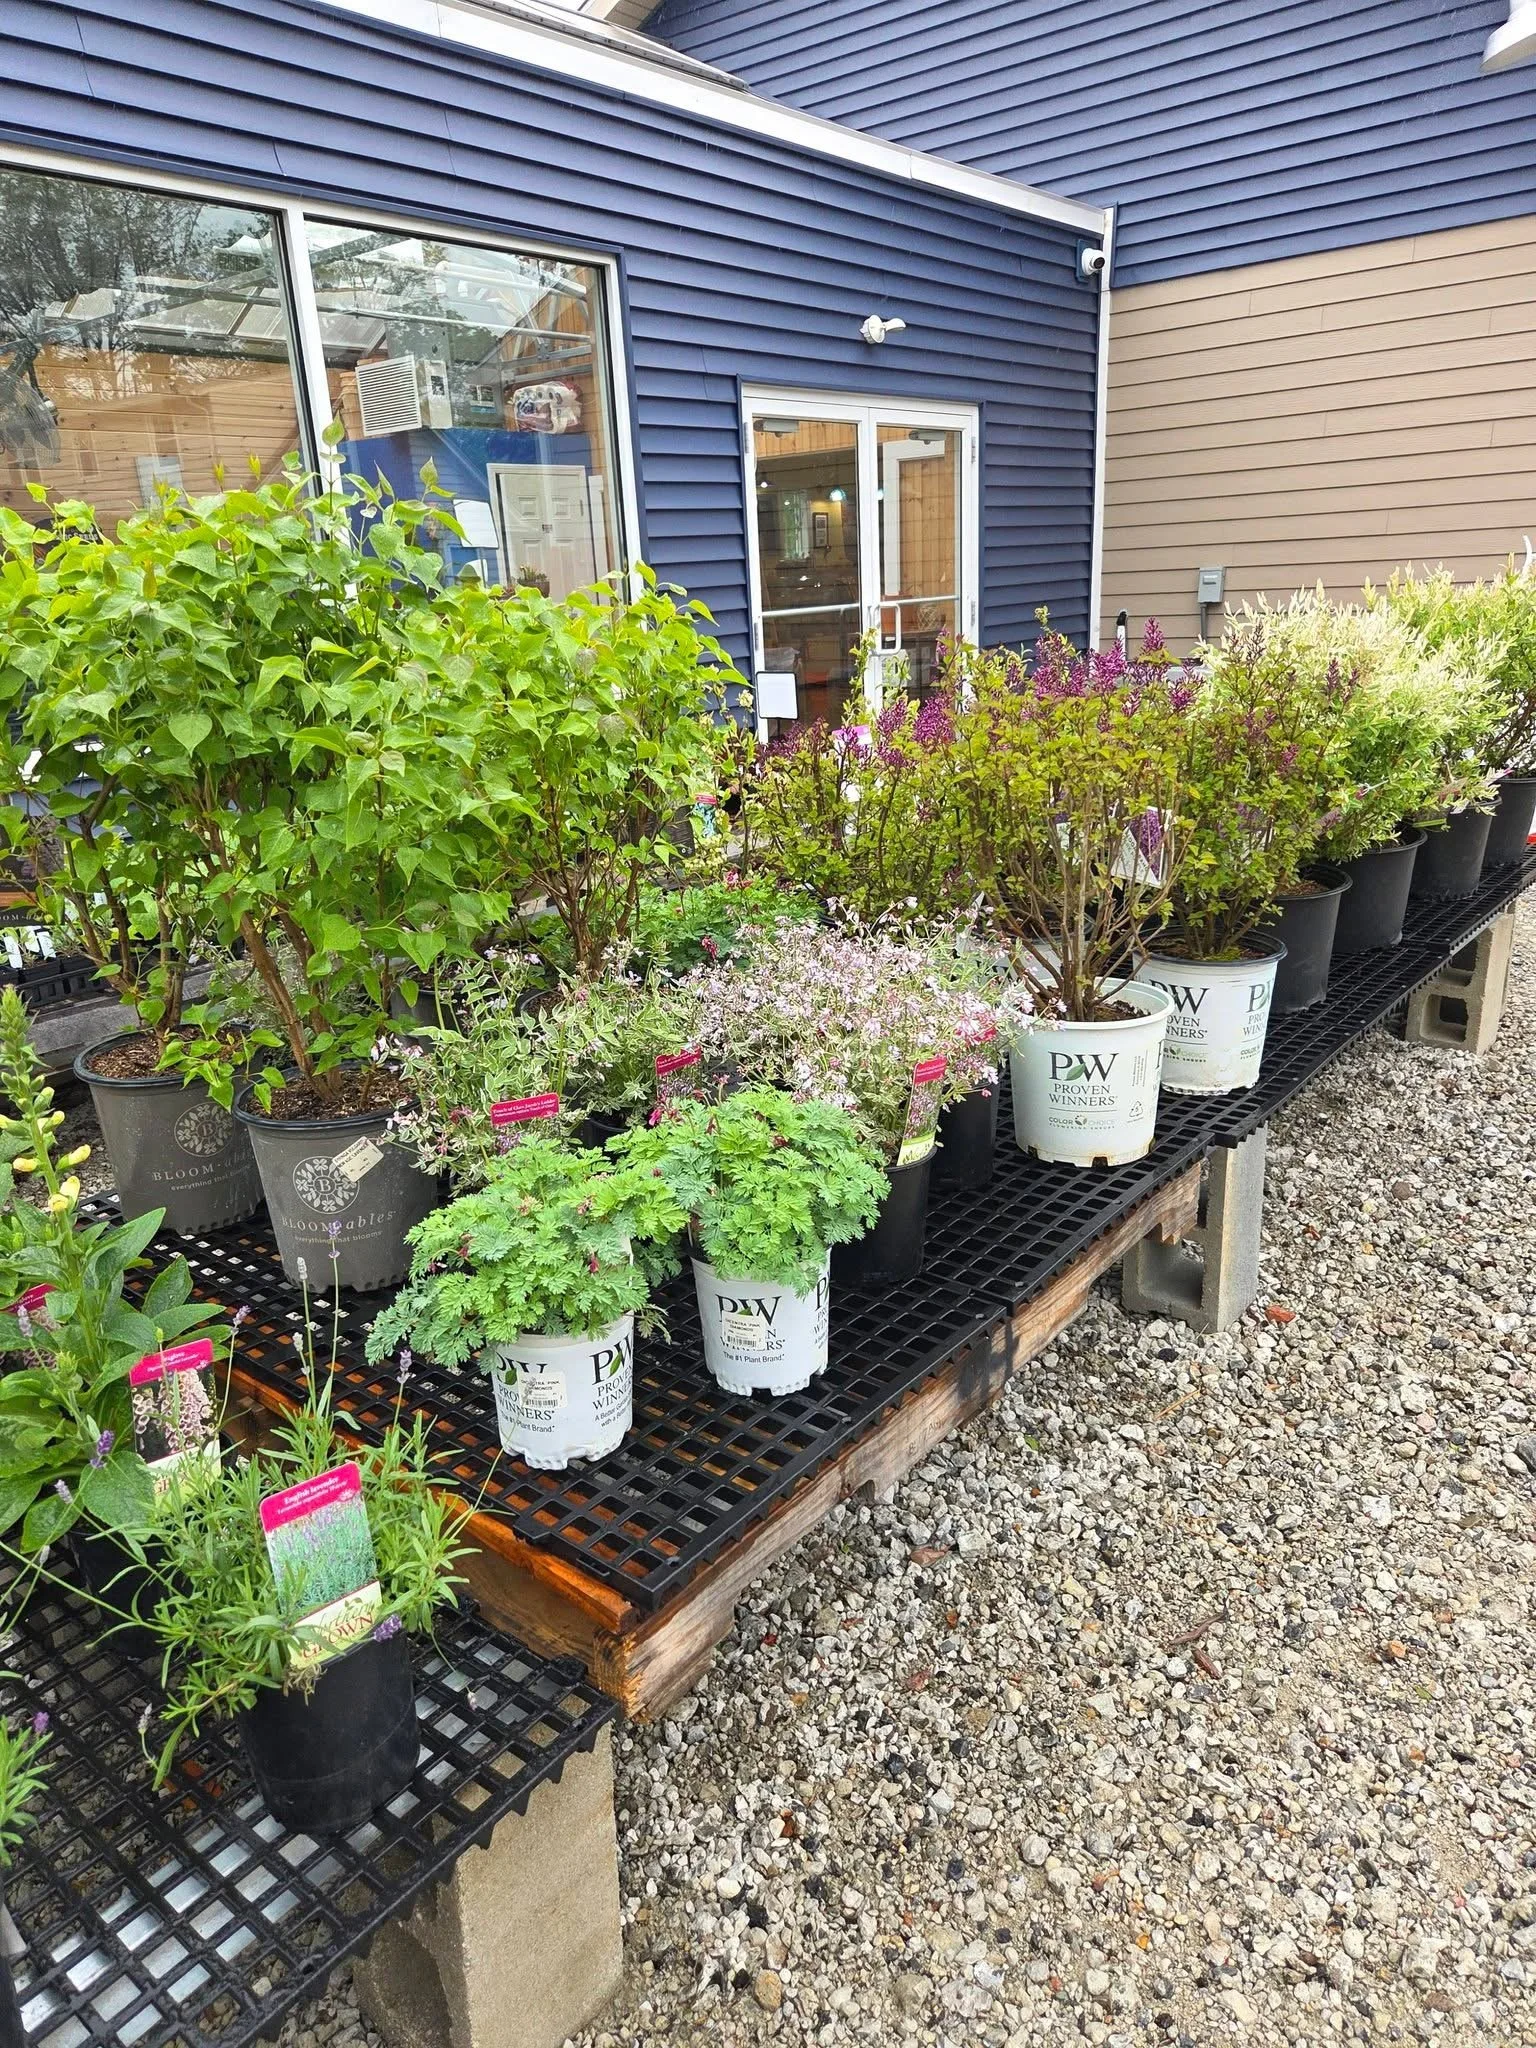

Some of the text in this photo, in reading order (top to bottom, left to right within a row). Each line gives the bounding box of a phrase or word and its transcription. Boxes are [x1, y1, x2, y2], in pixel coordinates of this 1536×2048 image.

[1167, 1015, 1200, 1027] OVEN
[1048, 1051, 1119, 1082] PW
[1054, 1083, 1111, 1095] PROVEN
[1048, 1093, 1115, 1107] WINNERS
[1048, 1116, 1074, 1125] COLOR
[153, 1164, 214, 1181] BLOOM
[319, 1179, 331, 1192] B
[353, 1230, 382, 1241] blooms
[723, 1351, 734, 1360] The
[744, 1355, 761, 1363] Plant
[284, 1476, 339, 1505] English lavender
